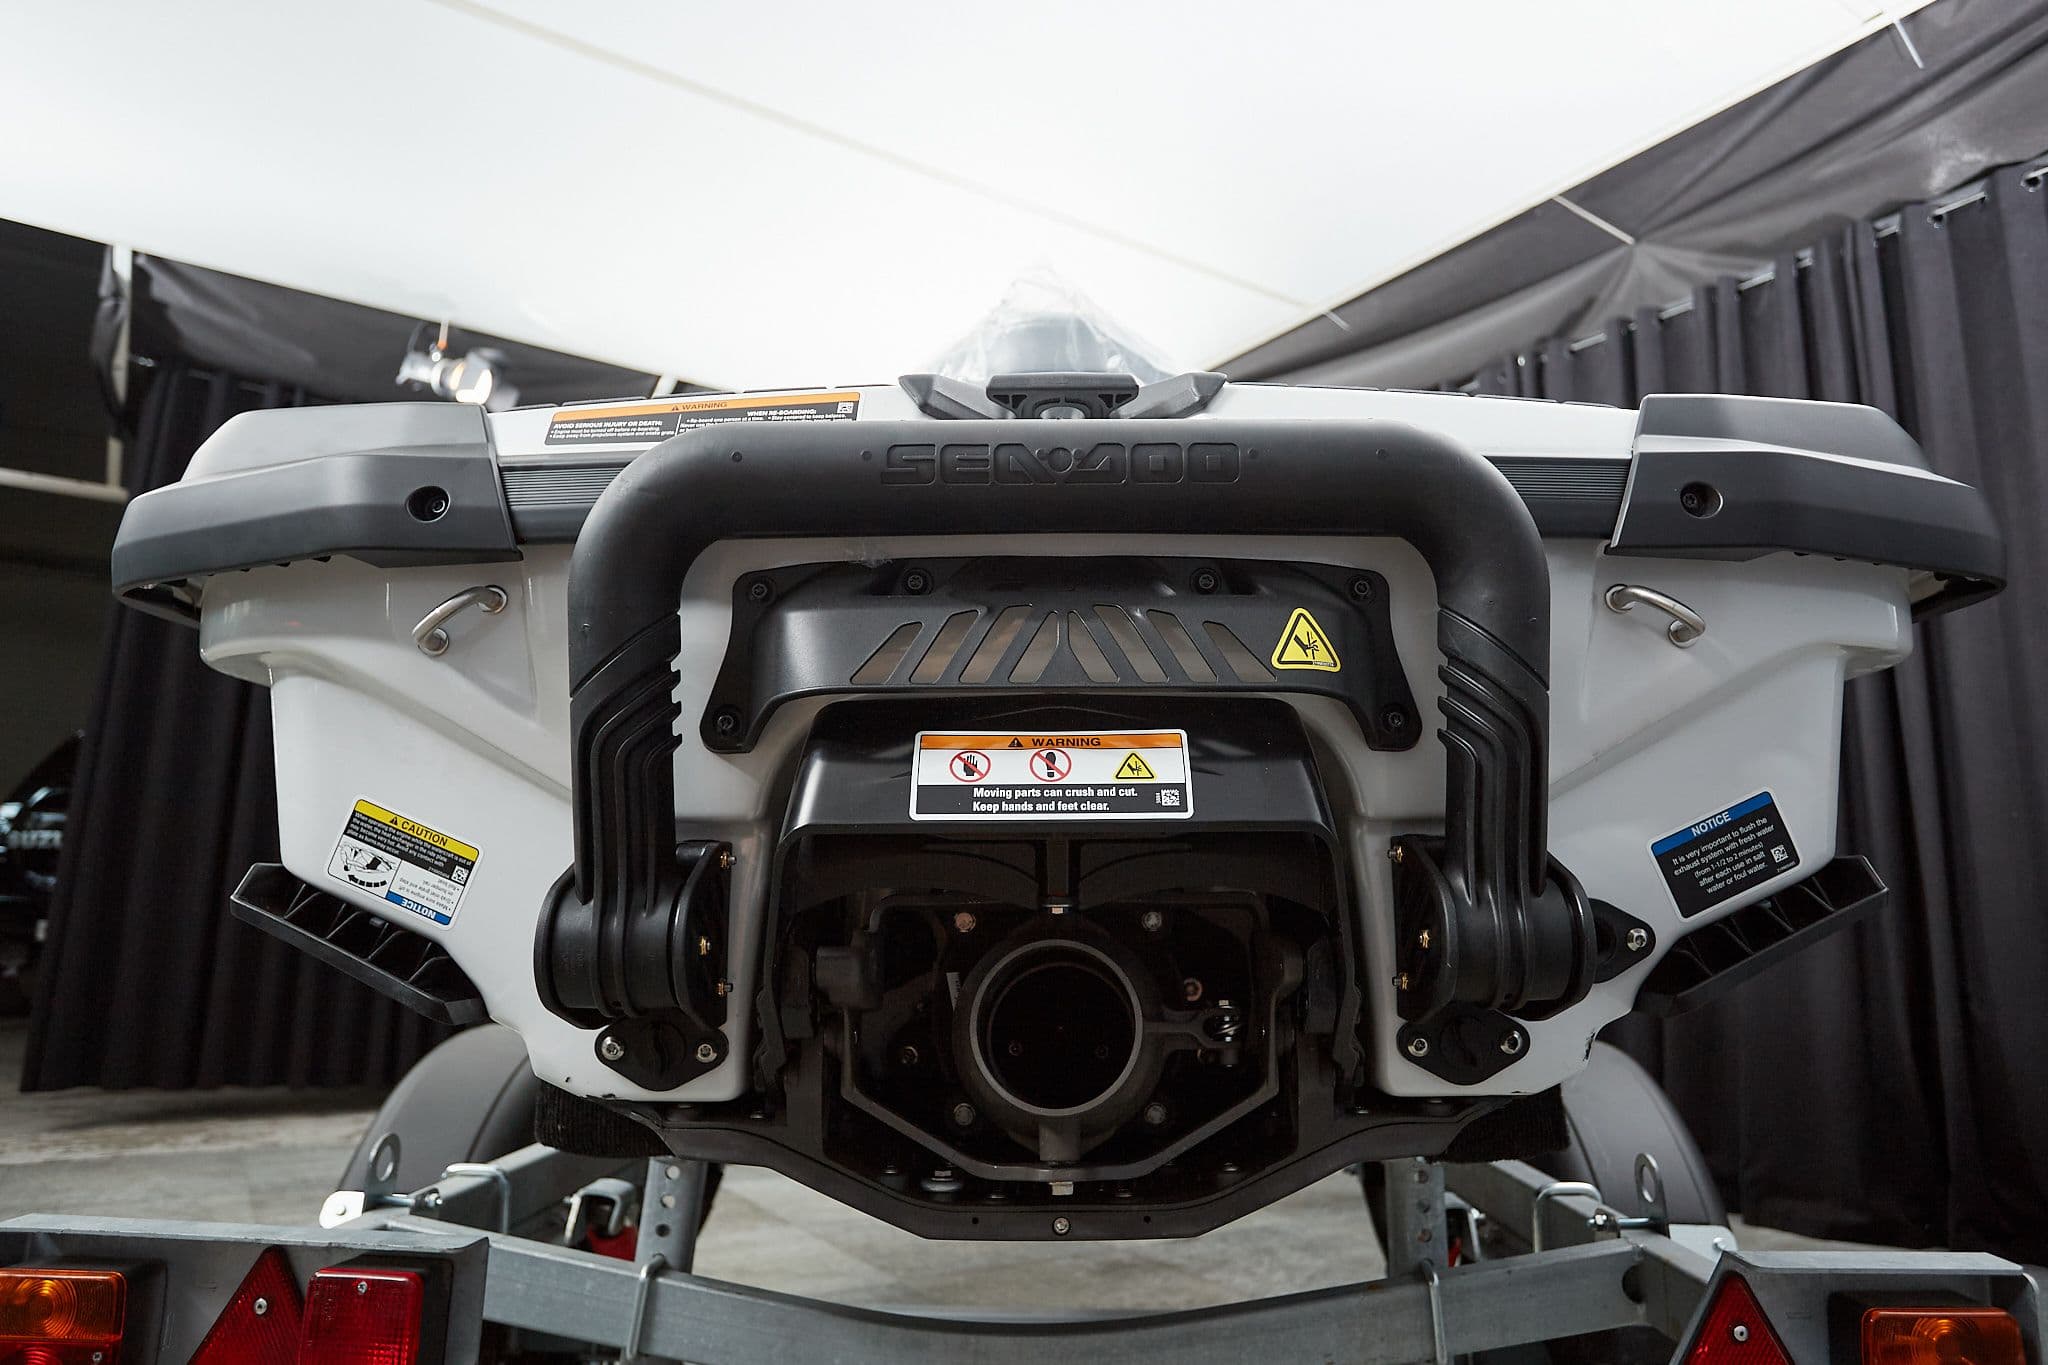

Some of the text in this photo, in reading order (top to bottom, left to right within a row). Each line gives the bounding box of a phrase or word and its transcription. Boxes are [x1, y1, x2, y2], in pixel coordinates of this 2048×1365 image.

[682, 401, 728, 411] WARNING
[1032, 738, 1101, 747] WARNING
[973, 787, 1138, 799] Moving parts can crush and cut.
[972, 800, 1110, 813] Keep hands and feet clear.
[400, 820, 448, 846] CAUTION
[1690, 810, 1732, 836] NOTICE
[1671, 816, 1767, 865] It is very important to flush the
[1672, 823, 1775, 876] exhaust system with fresh water
[1693, 865, 1711, 878] (from
[1710, 858, 1727, 870] 1-1/2
[1726, 855, 1734, 863] to
[1737, 840, 1764, 858] minutes)
[1698, 850, 1765, 886] after each use in salt
[1706, 880, 1726, 894] water
[1725, 877, 1733, 885] or
[1733, 869, 1747, 881] foul
[400, 897, 436, 919] NOTICE
